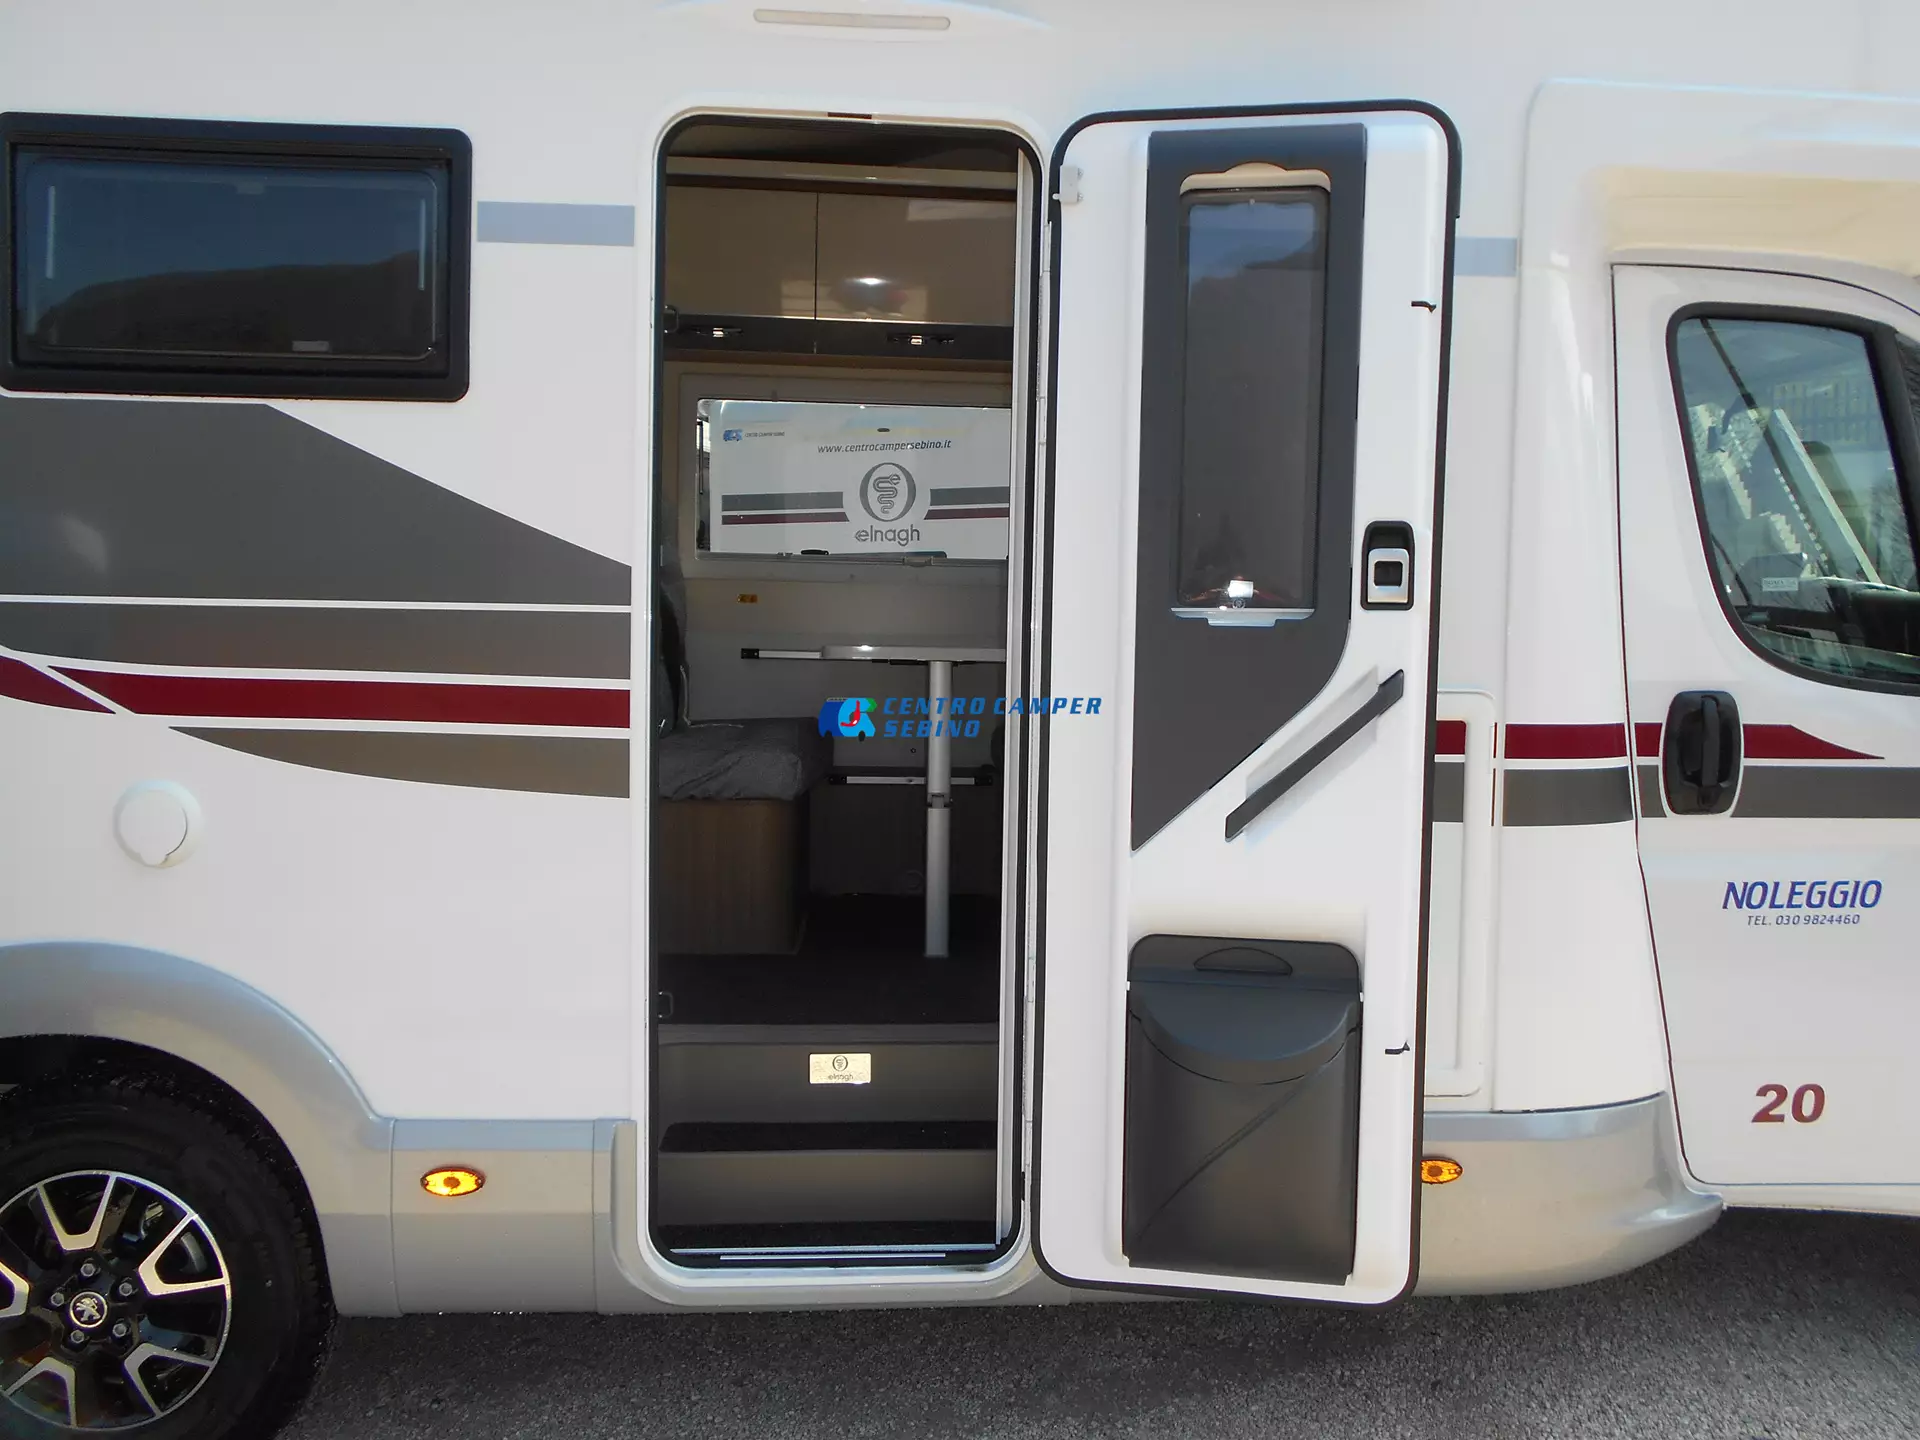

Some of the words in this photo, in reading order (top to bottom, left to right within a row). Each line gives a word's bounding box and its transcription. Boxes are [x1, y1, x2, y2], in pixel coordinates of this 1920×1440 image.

[817, 440, 952, 453] www.centrocampersebino.it
[855, 524, 921, 547] elnagh
[1722, 880, 1883, 910] NOLEGGIO
[1747, 915, 1772, 926] TEL.
[1775, 914, 1800, 925] 030
[1803, 914, 1861, 925] 9824460
[1751, 1083, 1826, 1123] 20
